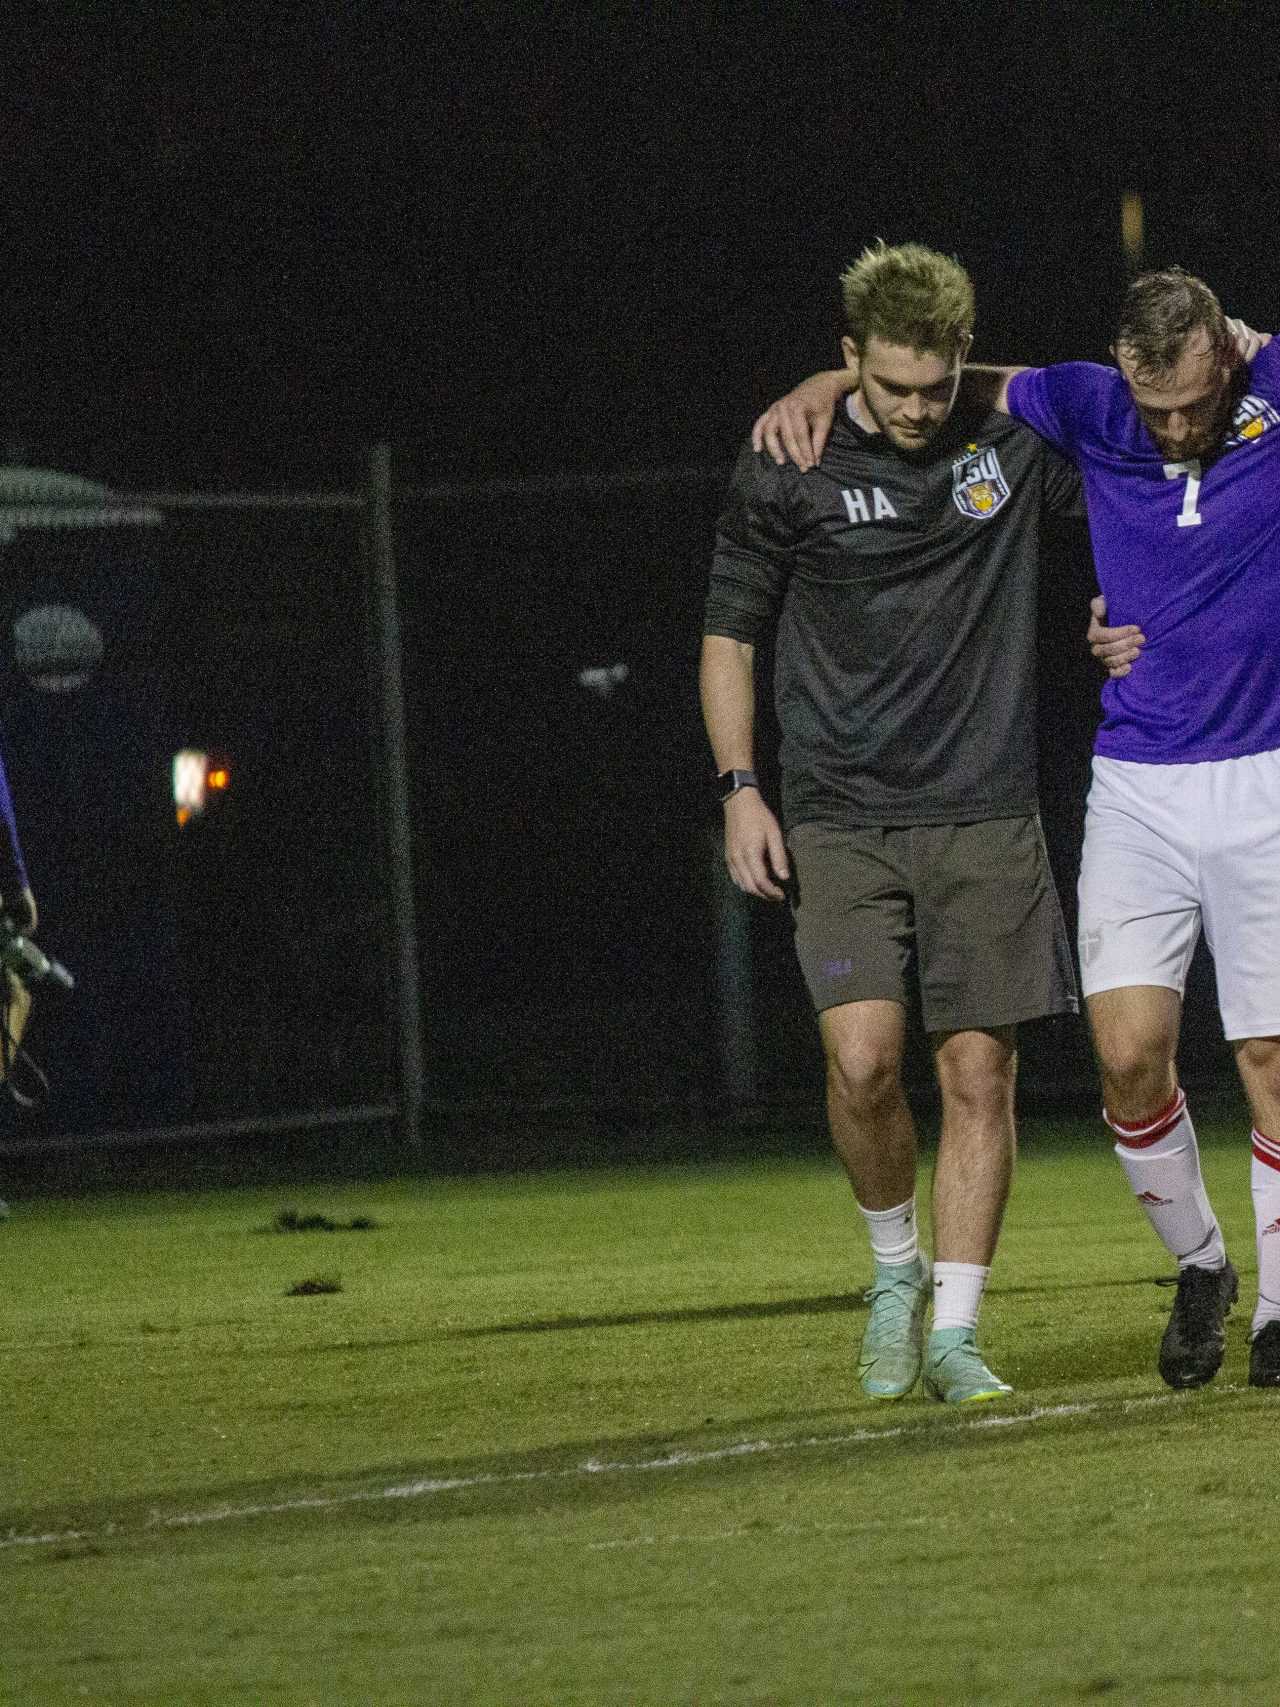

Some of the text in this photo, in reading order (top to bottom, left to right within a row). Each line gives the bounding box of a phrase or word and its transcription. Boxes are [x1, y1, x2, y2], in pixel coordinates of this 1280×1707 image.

[955, 451, 998, 493] LSU
[840, 486, 898, 523] HA
[1162, 460, 1202, 527] 7
